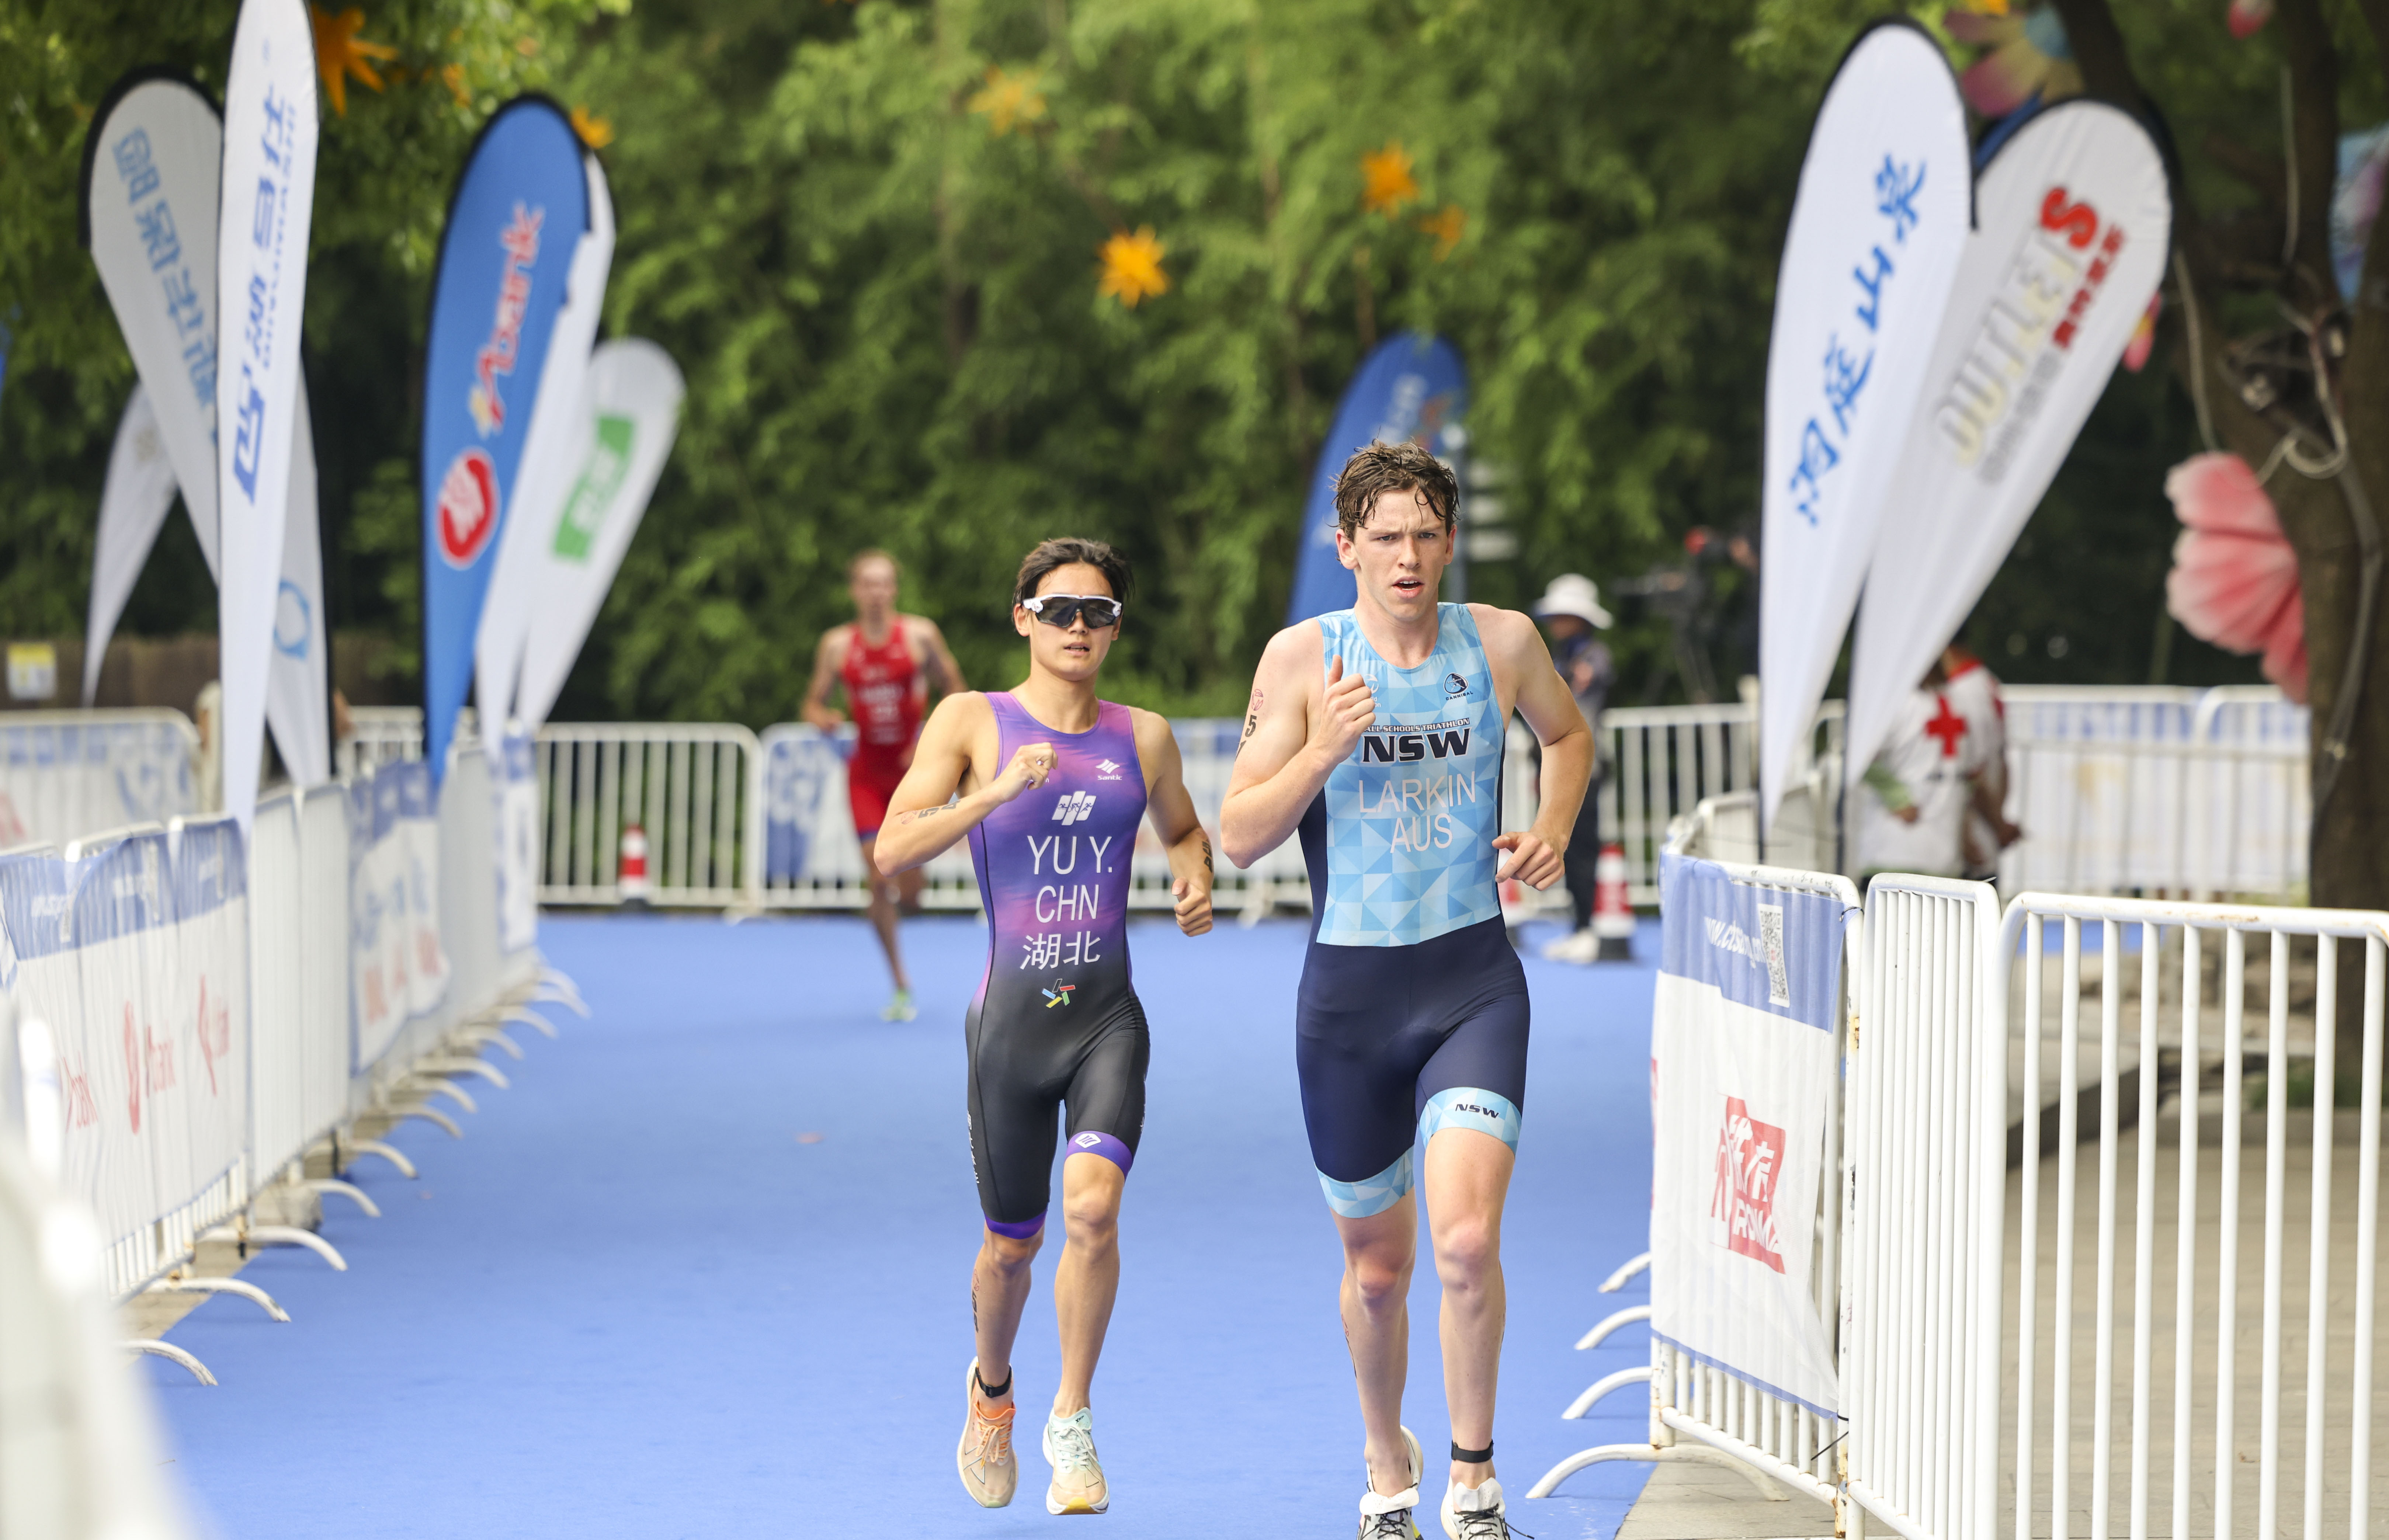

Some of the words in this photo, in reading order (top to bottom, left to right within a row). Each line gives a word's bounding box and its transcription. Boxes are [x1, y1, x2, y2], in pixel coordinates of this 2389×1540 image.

[1789, 152, 1927, 527] 洞庭山泉
[1935, 186, 2098, 465] OUTLETS
[1445, 691, 1473, 701] CANNIBAL
[1421, 717, 1470, 731] TRIATHLON
[1361, 727, 1472, 763] NSW
[1359, 771, 1476, 813] LARKIN
[1390, 813, 1453, 854] AUS
[1027, 835, 1077, 875] YU
[1089, 836, 1113, 874] Y.
[1036, 884, 1099, 923] CHN
[1020, 930, 1102, 970] 湖北
[1455, 1103, 1501, 1119] NSW
